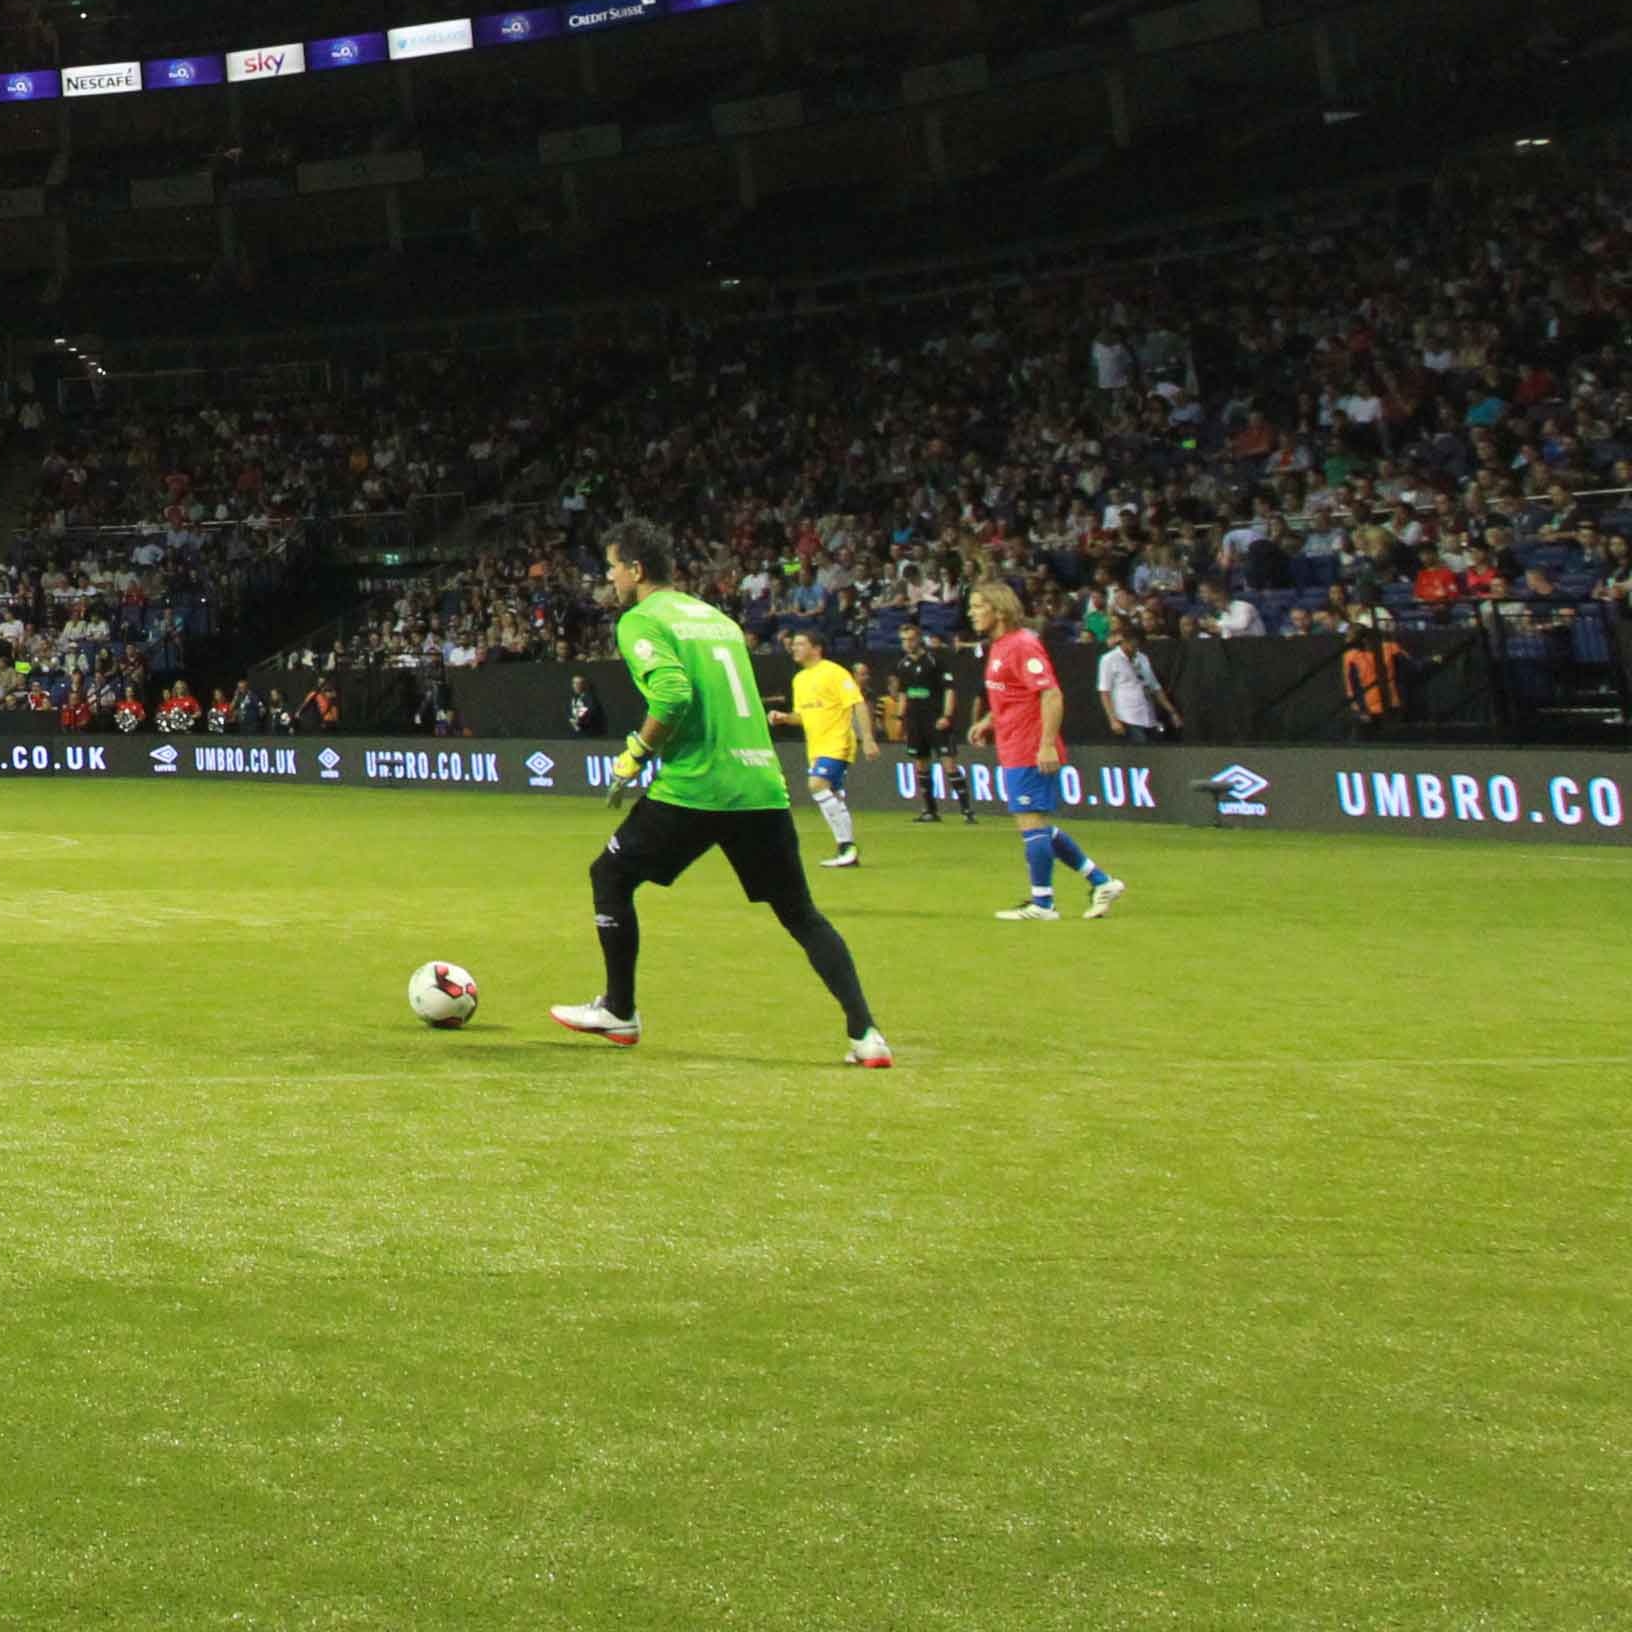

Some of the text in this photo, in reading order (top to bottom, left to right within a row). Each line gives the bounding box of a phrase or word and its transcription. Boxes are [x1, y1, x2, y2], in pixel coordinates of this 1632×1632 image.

[243, 51, 286, 75] sky
[711, 646, 752, 718] 1
[194, 747, 297, 775] UMBRO.CO.UK
[1335, 770, 1624, 827] UMBRO.CO
